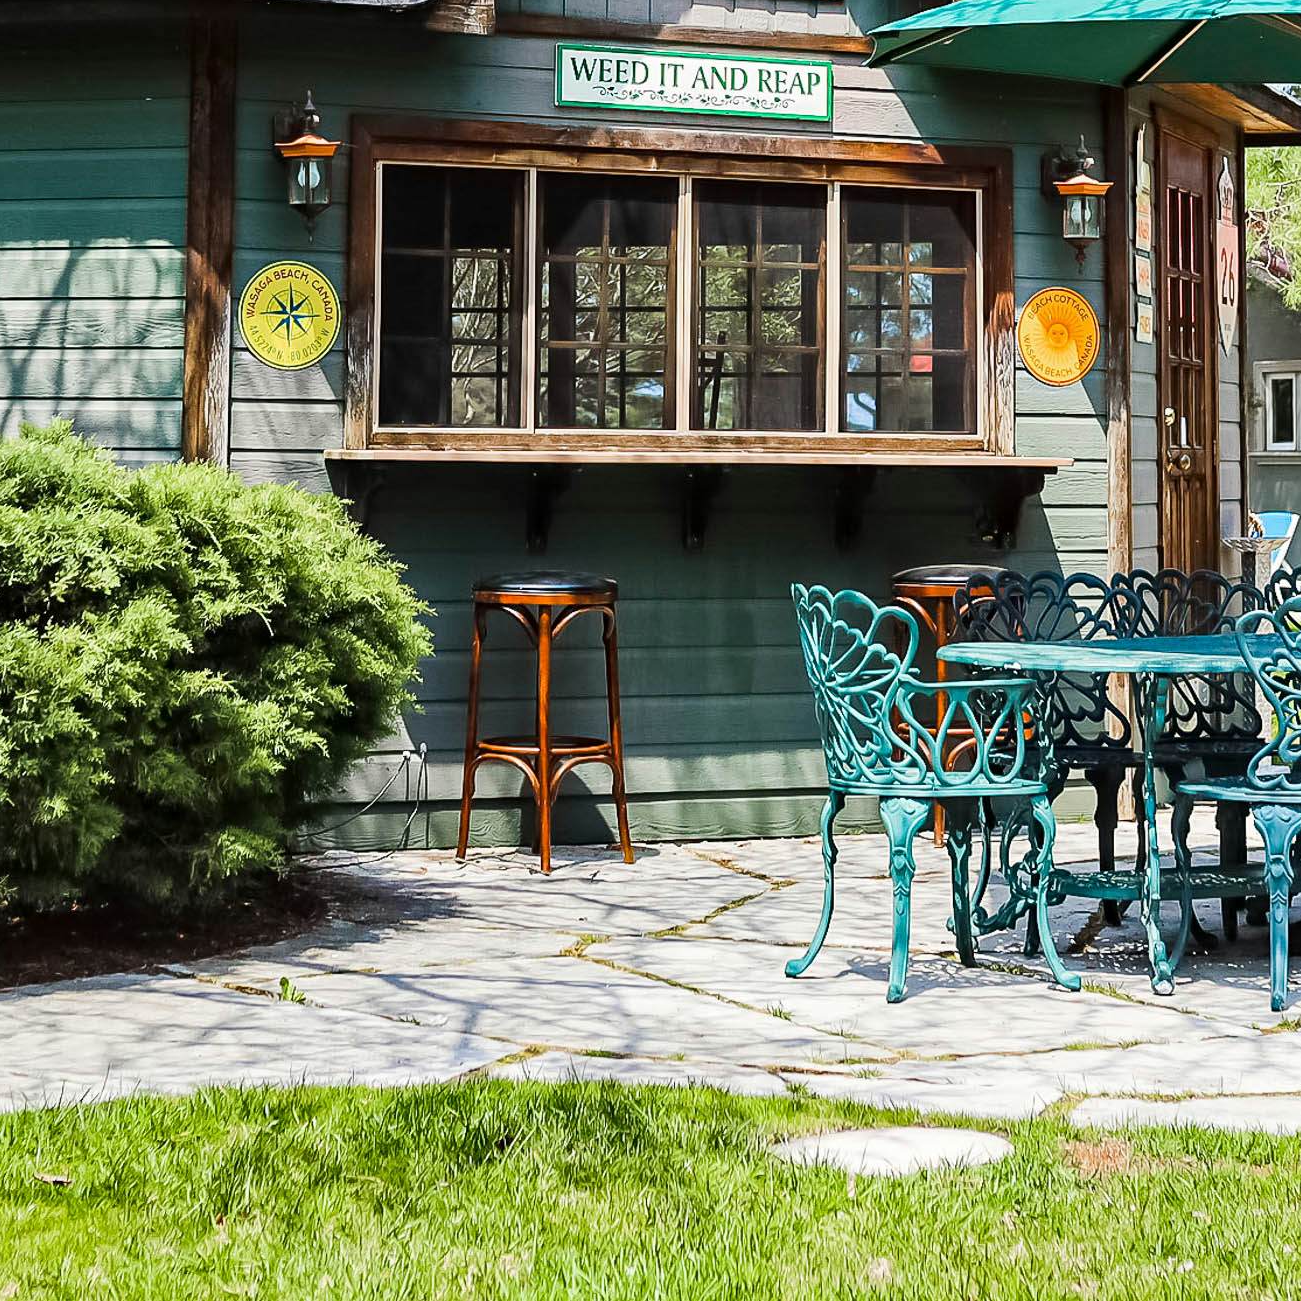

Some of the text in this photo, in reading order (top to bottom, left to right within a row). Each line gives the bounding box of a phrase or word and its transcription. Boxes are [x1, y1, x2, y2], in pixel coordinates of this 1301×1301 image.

[570, 56, 821, 95] WEED IT AND REAP
[246, 268, 333, 322] WASAGA BEACH, CANADA
[1220, 247, 1235, 307] 26
[1028, 294, 1089, 321] BEACH COTTAGE
[1023, 333, 1044, 372] WASAGA
[1074, 334, 1093, 370] CANADA
